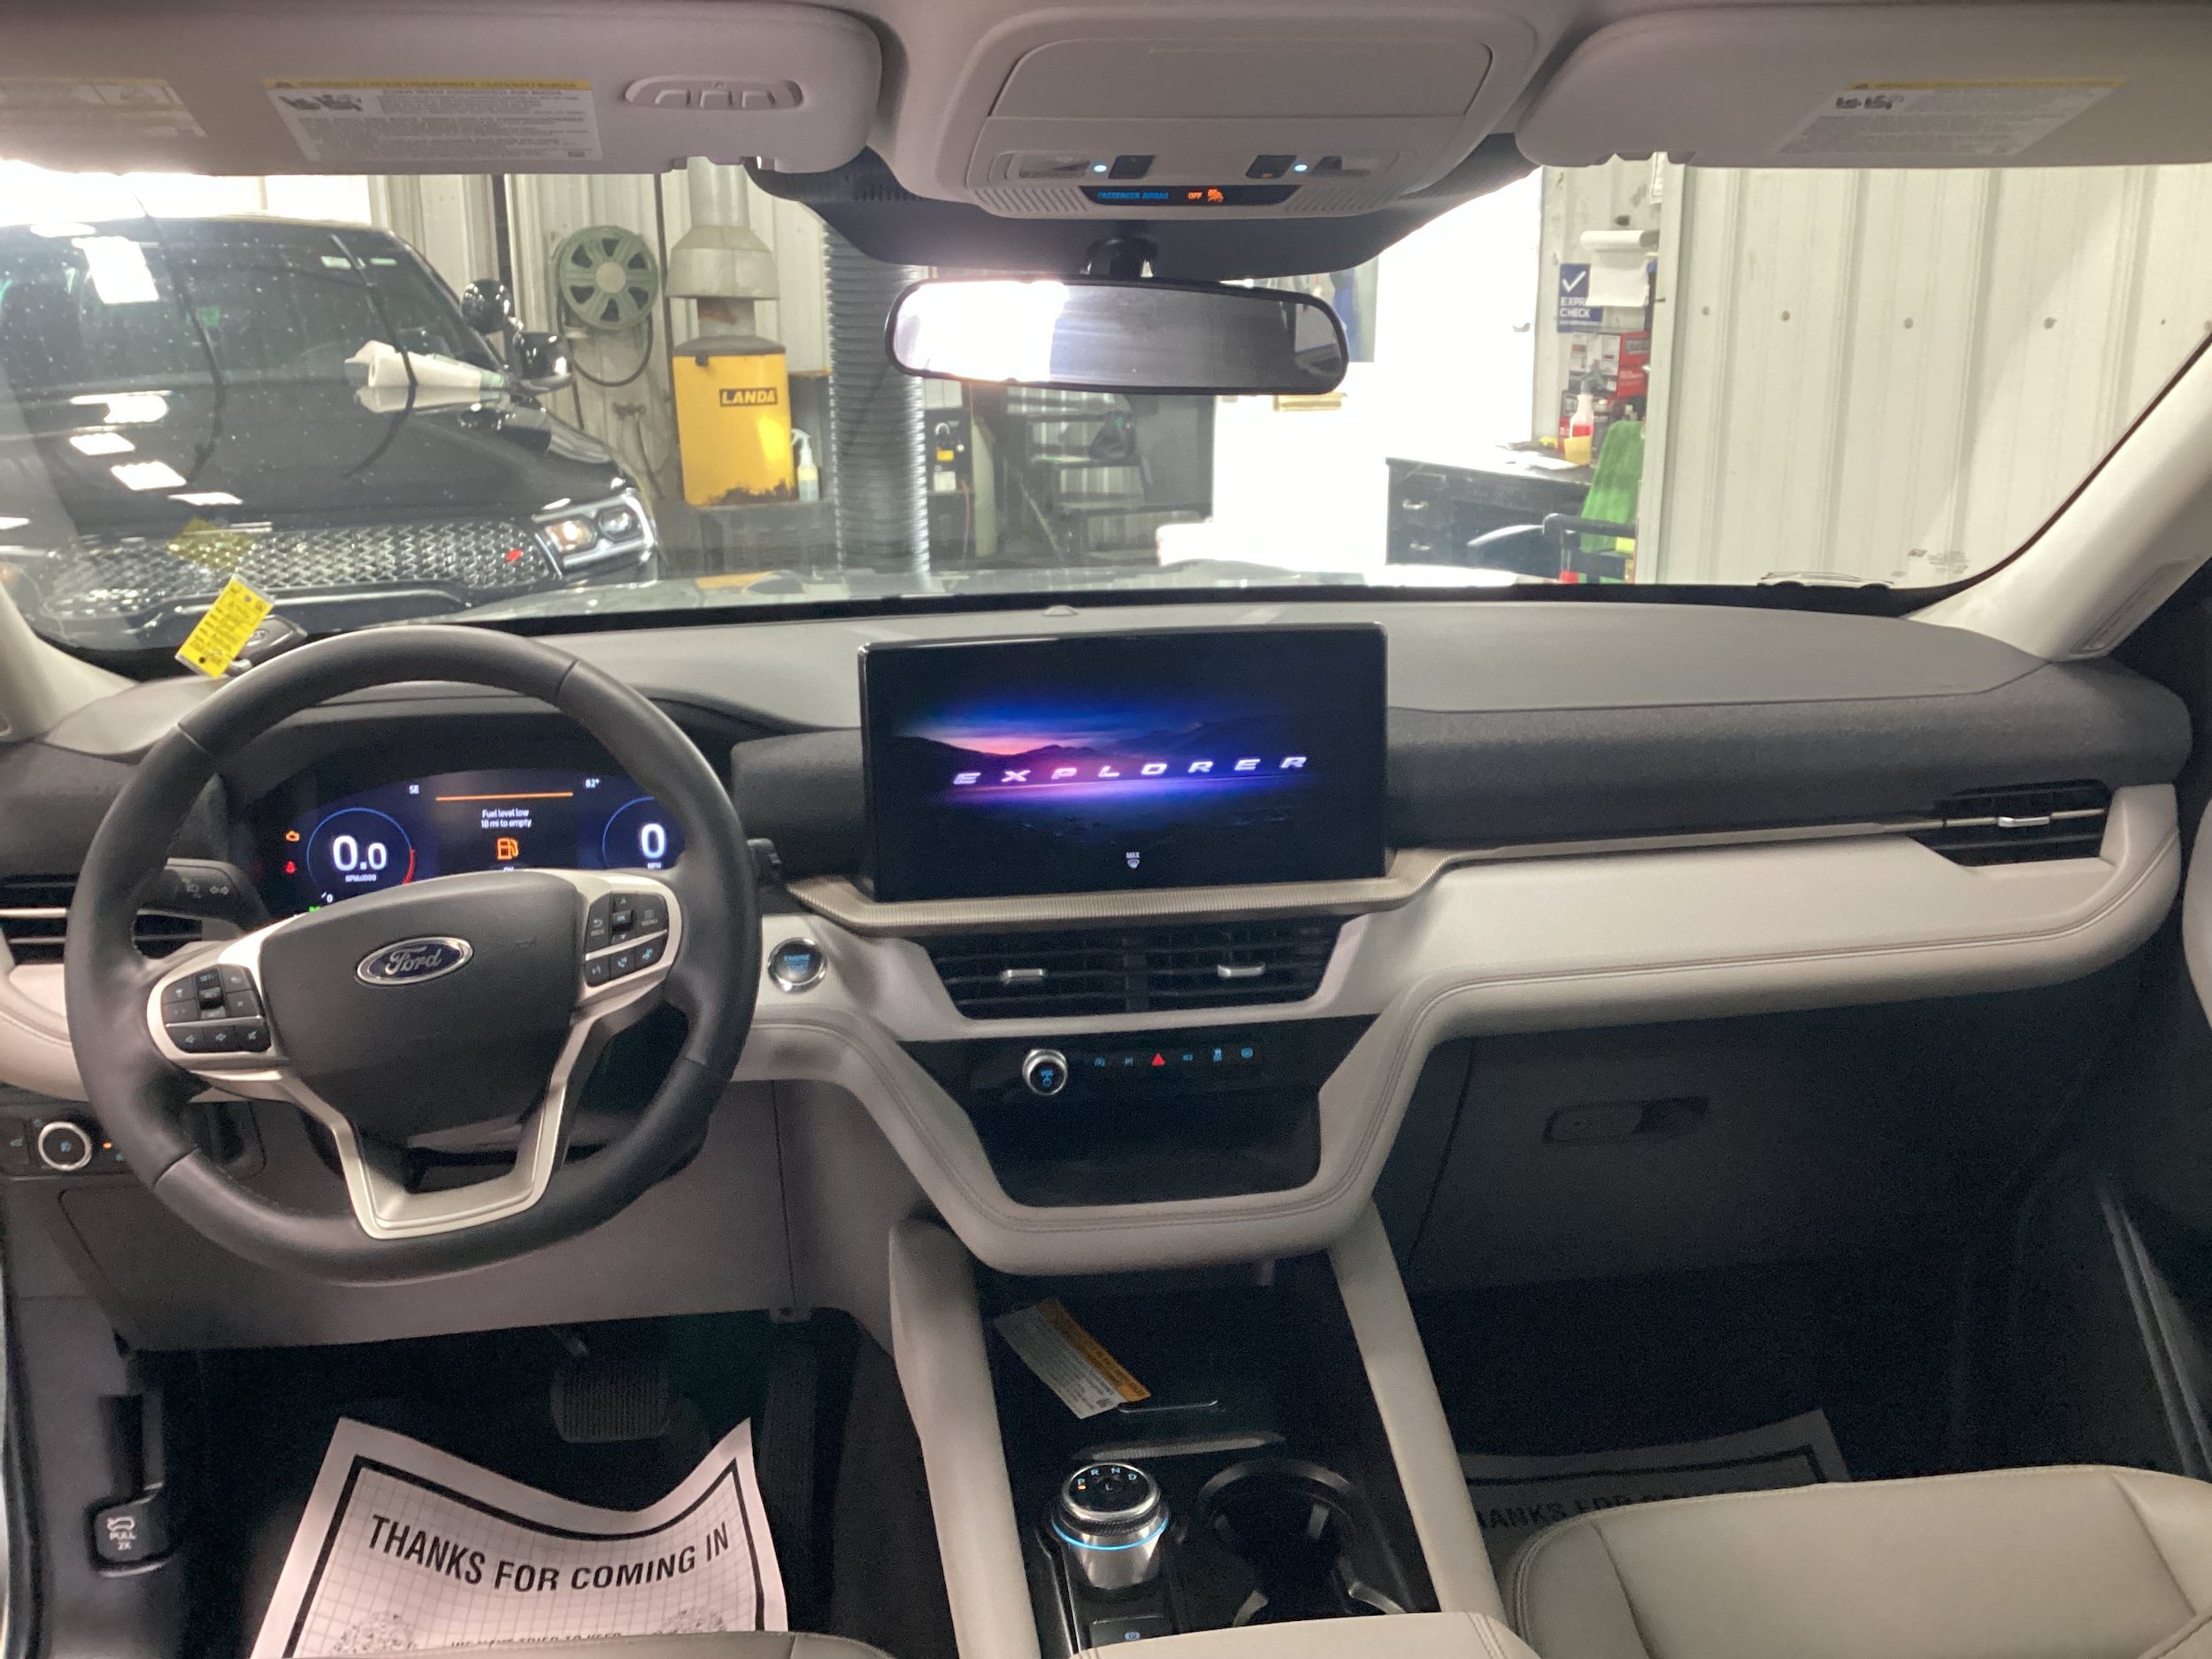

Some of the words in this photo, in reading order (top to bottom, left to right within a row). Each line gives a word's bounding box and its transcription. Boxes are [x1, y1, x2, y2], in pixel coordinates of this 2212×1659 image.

[1188, 191, 1203, 200] OFF
[1560, 307, 1591, 318] CHECK
[721, 389, 776, 404] LANDA
[953, 756, 1307, 786] EXPLORER
[482, 809, 497, 818] Fuel
[498, 809, 515, 818] level
[516, 808, 530, 817] low
[490, 819, 499, 828] mi
[500, 819, 509, 828] to
[509, 818, 533, 829] empty
[641, 823, 665, 858] 0
[333, 834, 388, 872] 0.0
[384, 946, 442, 975] Ford
[109, 1531, 137, 1540] PULL
[368, 1514, 485, 1585] THANKS
[493, 1560, 559, 1592] FOR
[571, 1545, 696, 1590] COMING
[706, 1521, 729, 1562] IN
